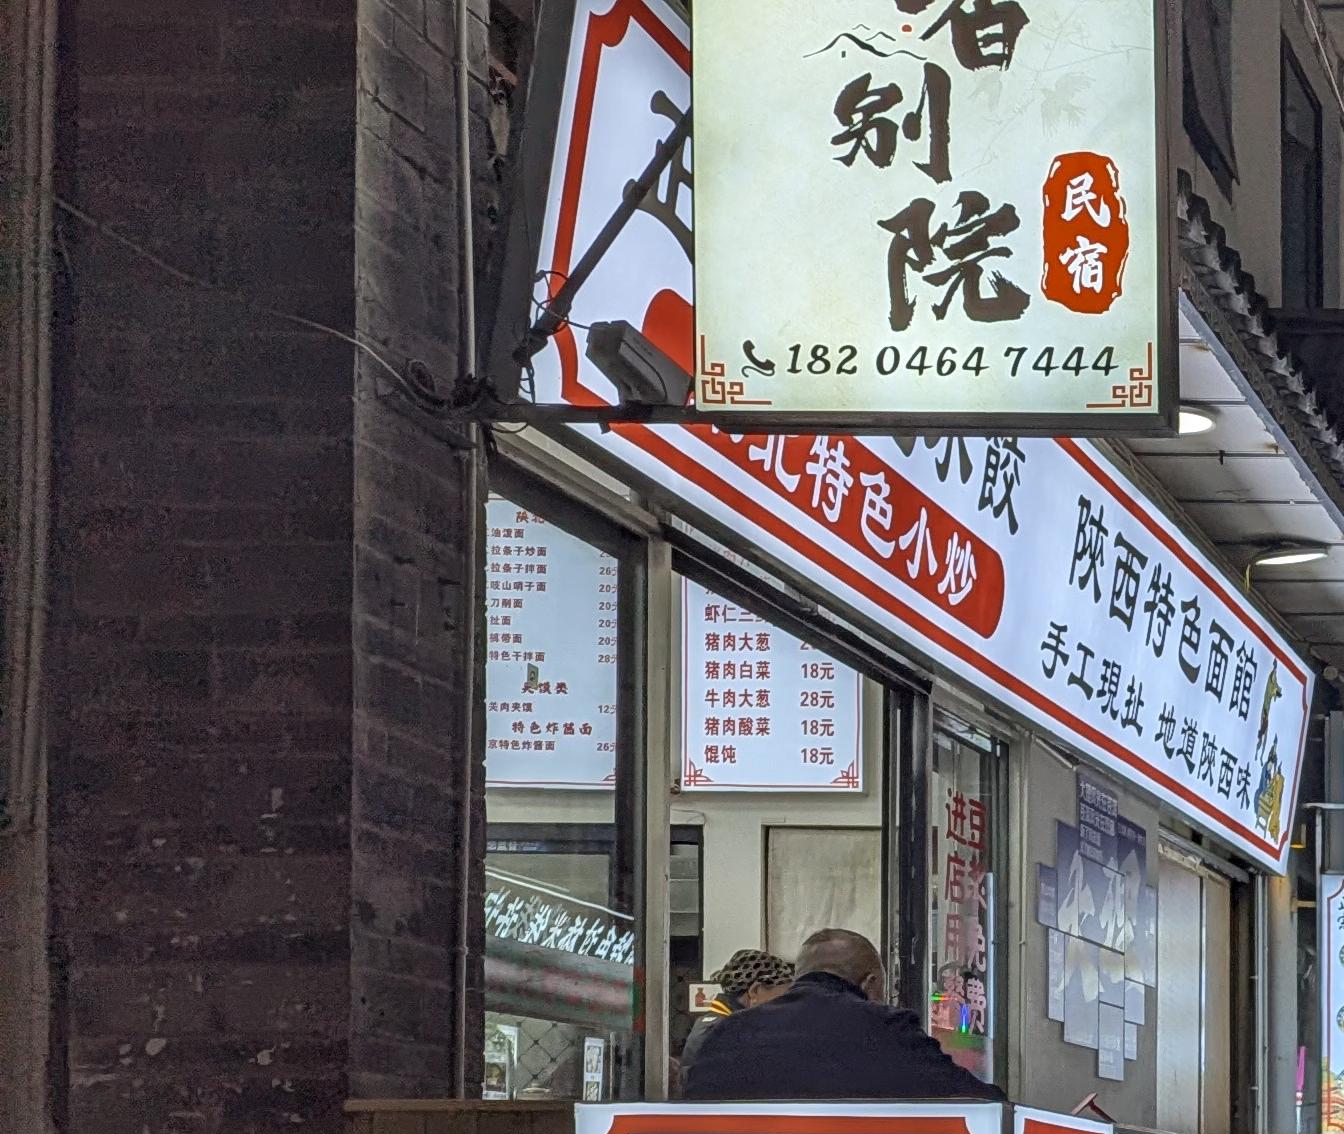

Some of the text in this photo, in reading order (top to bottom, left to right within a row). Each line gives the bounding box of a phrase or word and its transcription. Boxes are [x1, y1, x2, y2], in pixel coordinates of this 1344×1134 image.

[1058, 172, 1111, 293] 民宿
[787, 344, 1119, 376] 182 0464 7444
[711, 424, 978, 607] 北特色小炒
[491, 545, 547, 557] 拉条子炒面
[491, 562, 547, 575] 拉条子拌面
[490, 598, 523, 609] 刀削面
[704, 632, 771, 651] 猪肉大葱
[704, 661, 835, 680] 猪肉白菜 18元
[704, 689, 835, 708] 牛肉大葱 28元
[704, 717, 835, 736] 猪肉酸菜 18元
[704, 745, 834, 765] 馄饨 18元
